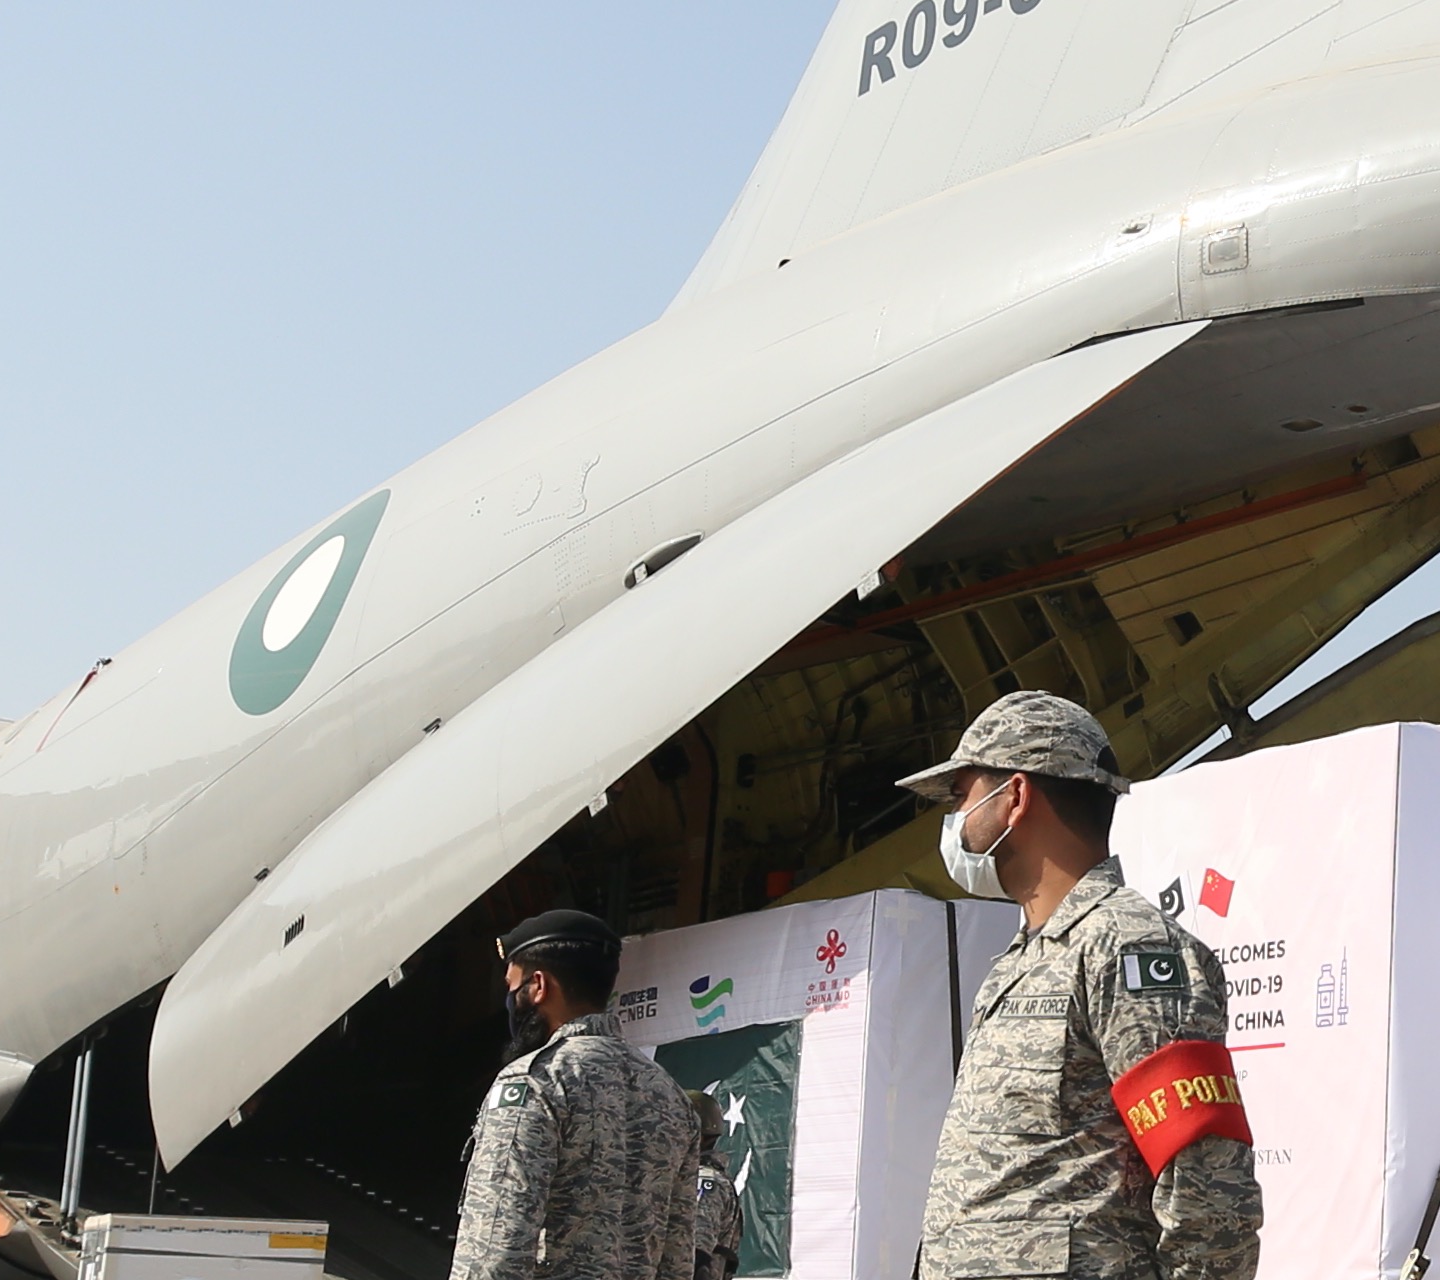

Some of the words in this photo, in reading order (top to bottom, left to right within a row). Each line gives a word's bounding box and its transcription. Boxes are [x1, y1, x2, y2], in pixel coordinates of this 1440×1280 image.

[1213, 939, 1286, 965] LCOMES
[805, 993, 832, 1006] CHINA
[835, 991, 850, 1001] AID
[1002, 1000, 1020, 1014] PAK
[1023, 1000, 1038, 1014] AIR
[1040, 999, 1068, 1014] FORCE
[1234, 1009, 1285, 1031] CHINA
[1127, 1088, 1168, 1136] PAF
